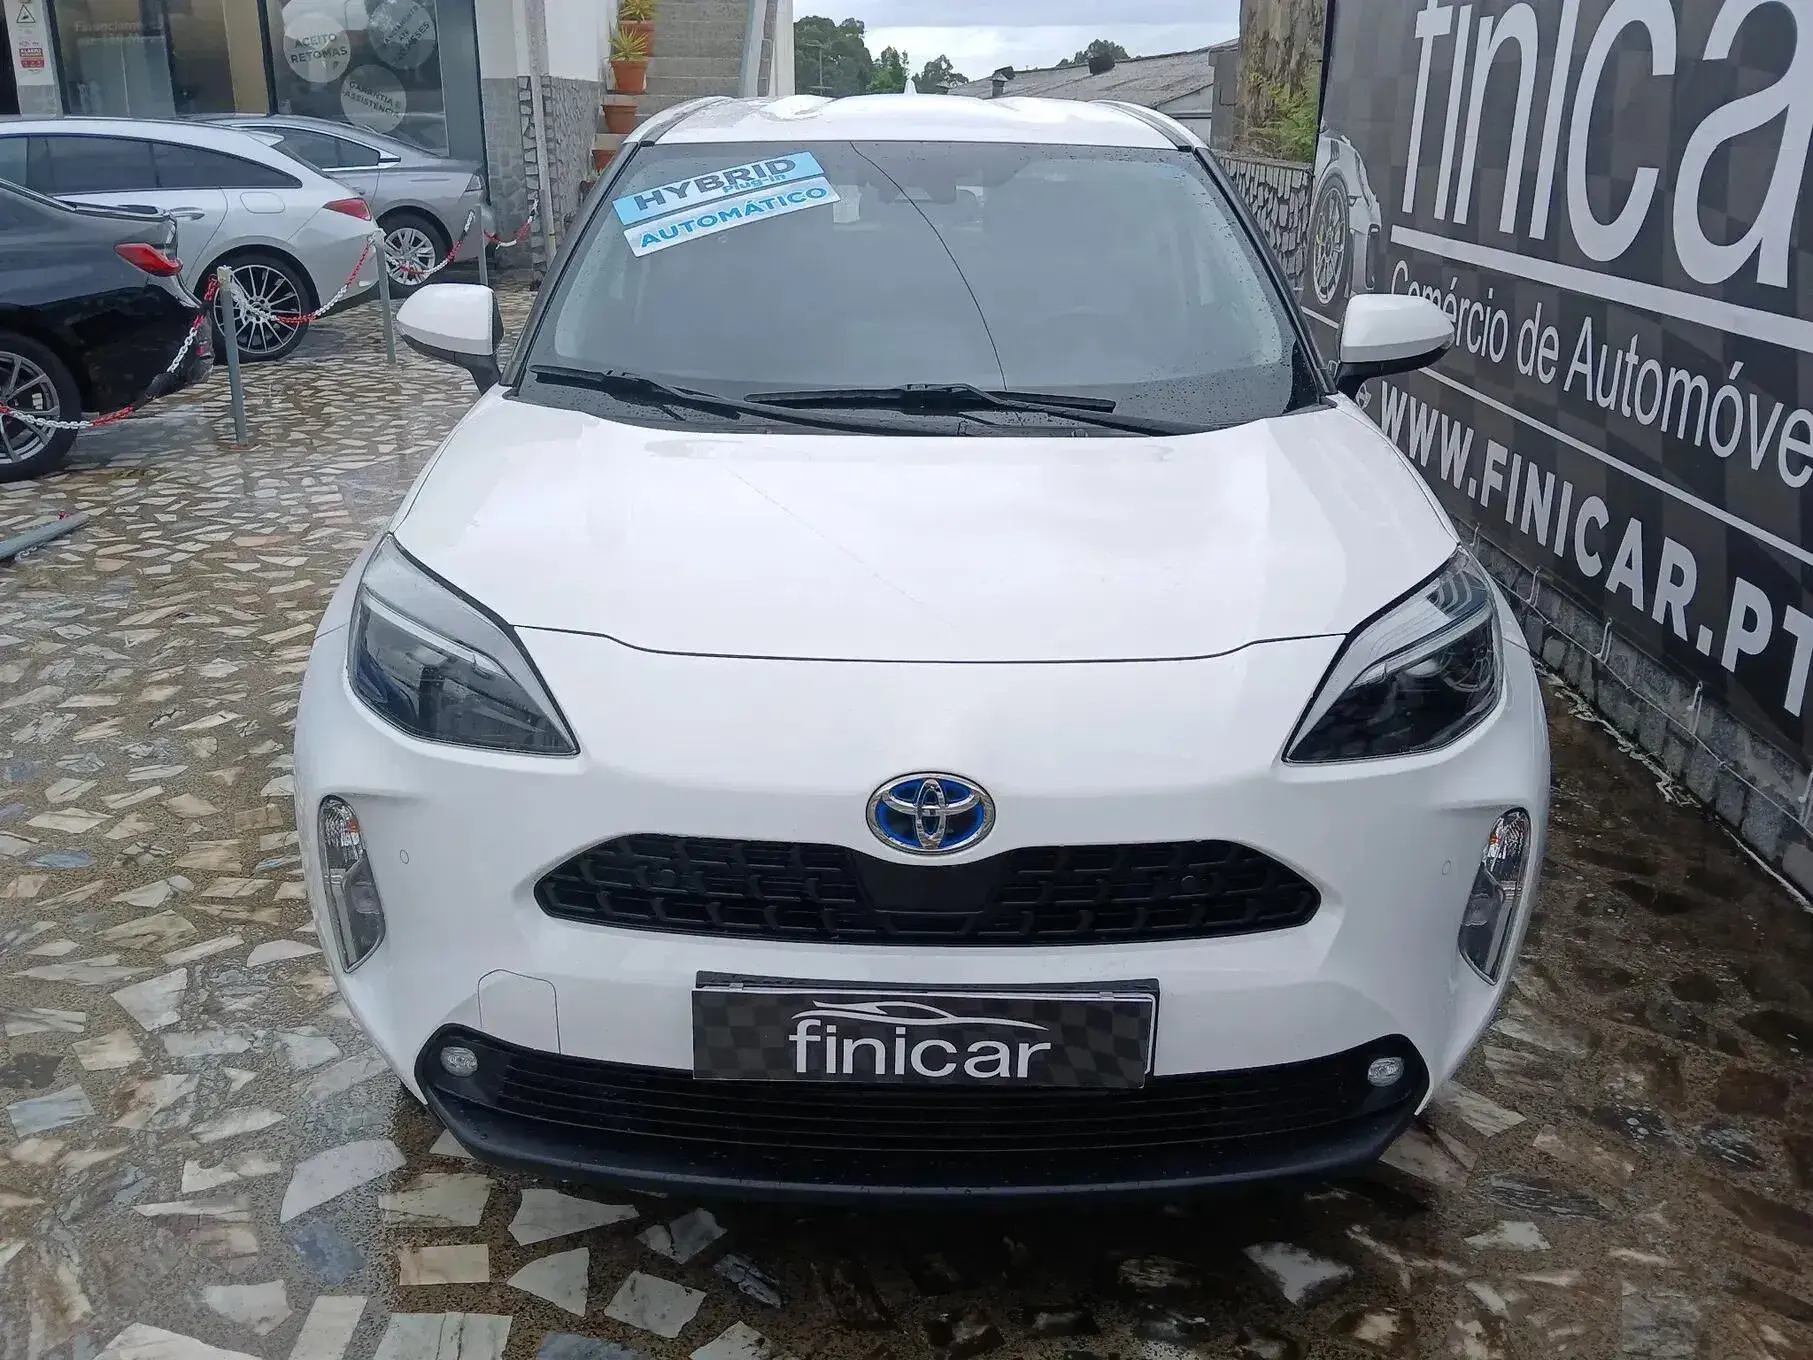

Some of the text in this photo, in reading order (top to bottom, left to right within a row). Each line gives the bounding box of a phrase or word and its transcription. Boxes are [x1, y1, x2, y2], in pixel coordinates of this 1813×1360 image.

[290, 46, 348, 63] RETOMAS
[294, 33, 337, 48] ACEITO
[633, 159, 796, 211] HYBRID
[640, 187, 827, 248] AUTOMÁTICO
[1516, 302, 1560, 384] de
[788, 1019, 1051, 1078] finicar
